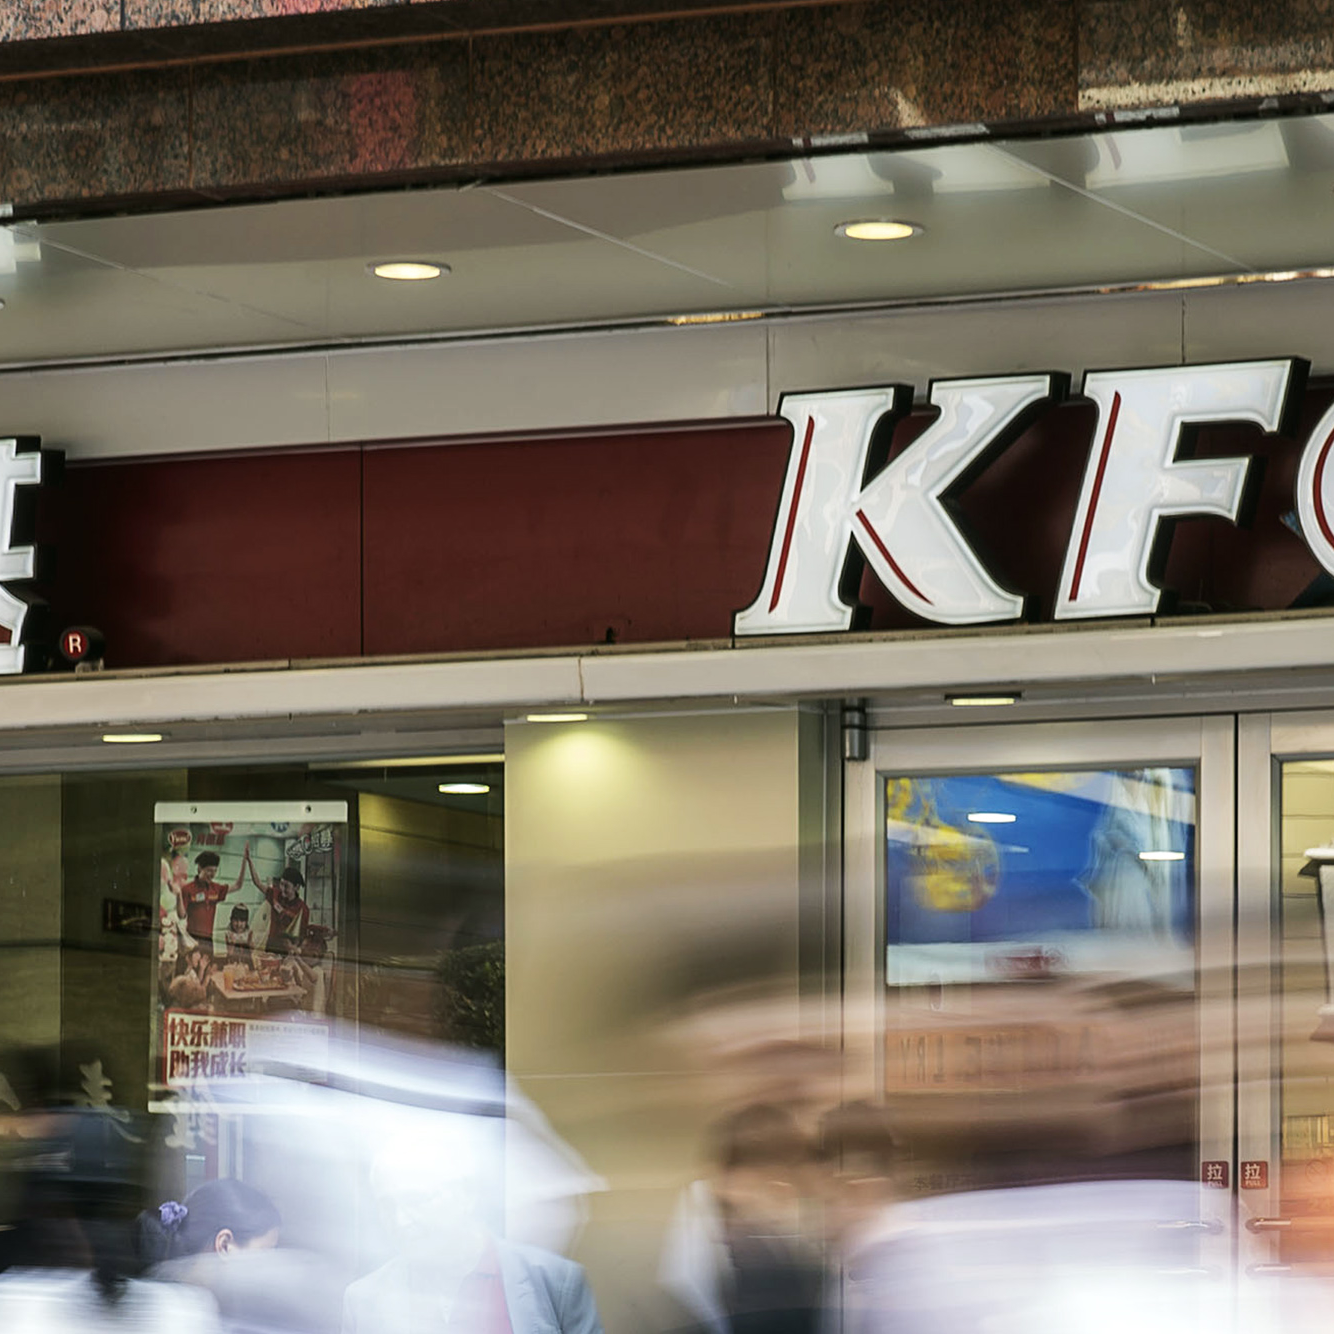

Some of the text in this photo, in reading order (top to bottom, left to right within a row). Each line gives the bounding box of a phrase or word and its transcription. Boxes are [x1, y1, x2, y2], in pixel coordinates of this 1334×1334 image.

[168, 1017, 247, 1049] 快乐兼职
[1207, 1163, 1223, 1180] 拉
[1245, 1163, 1261, 1180] 拉
